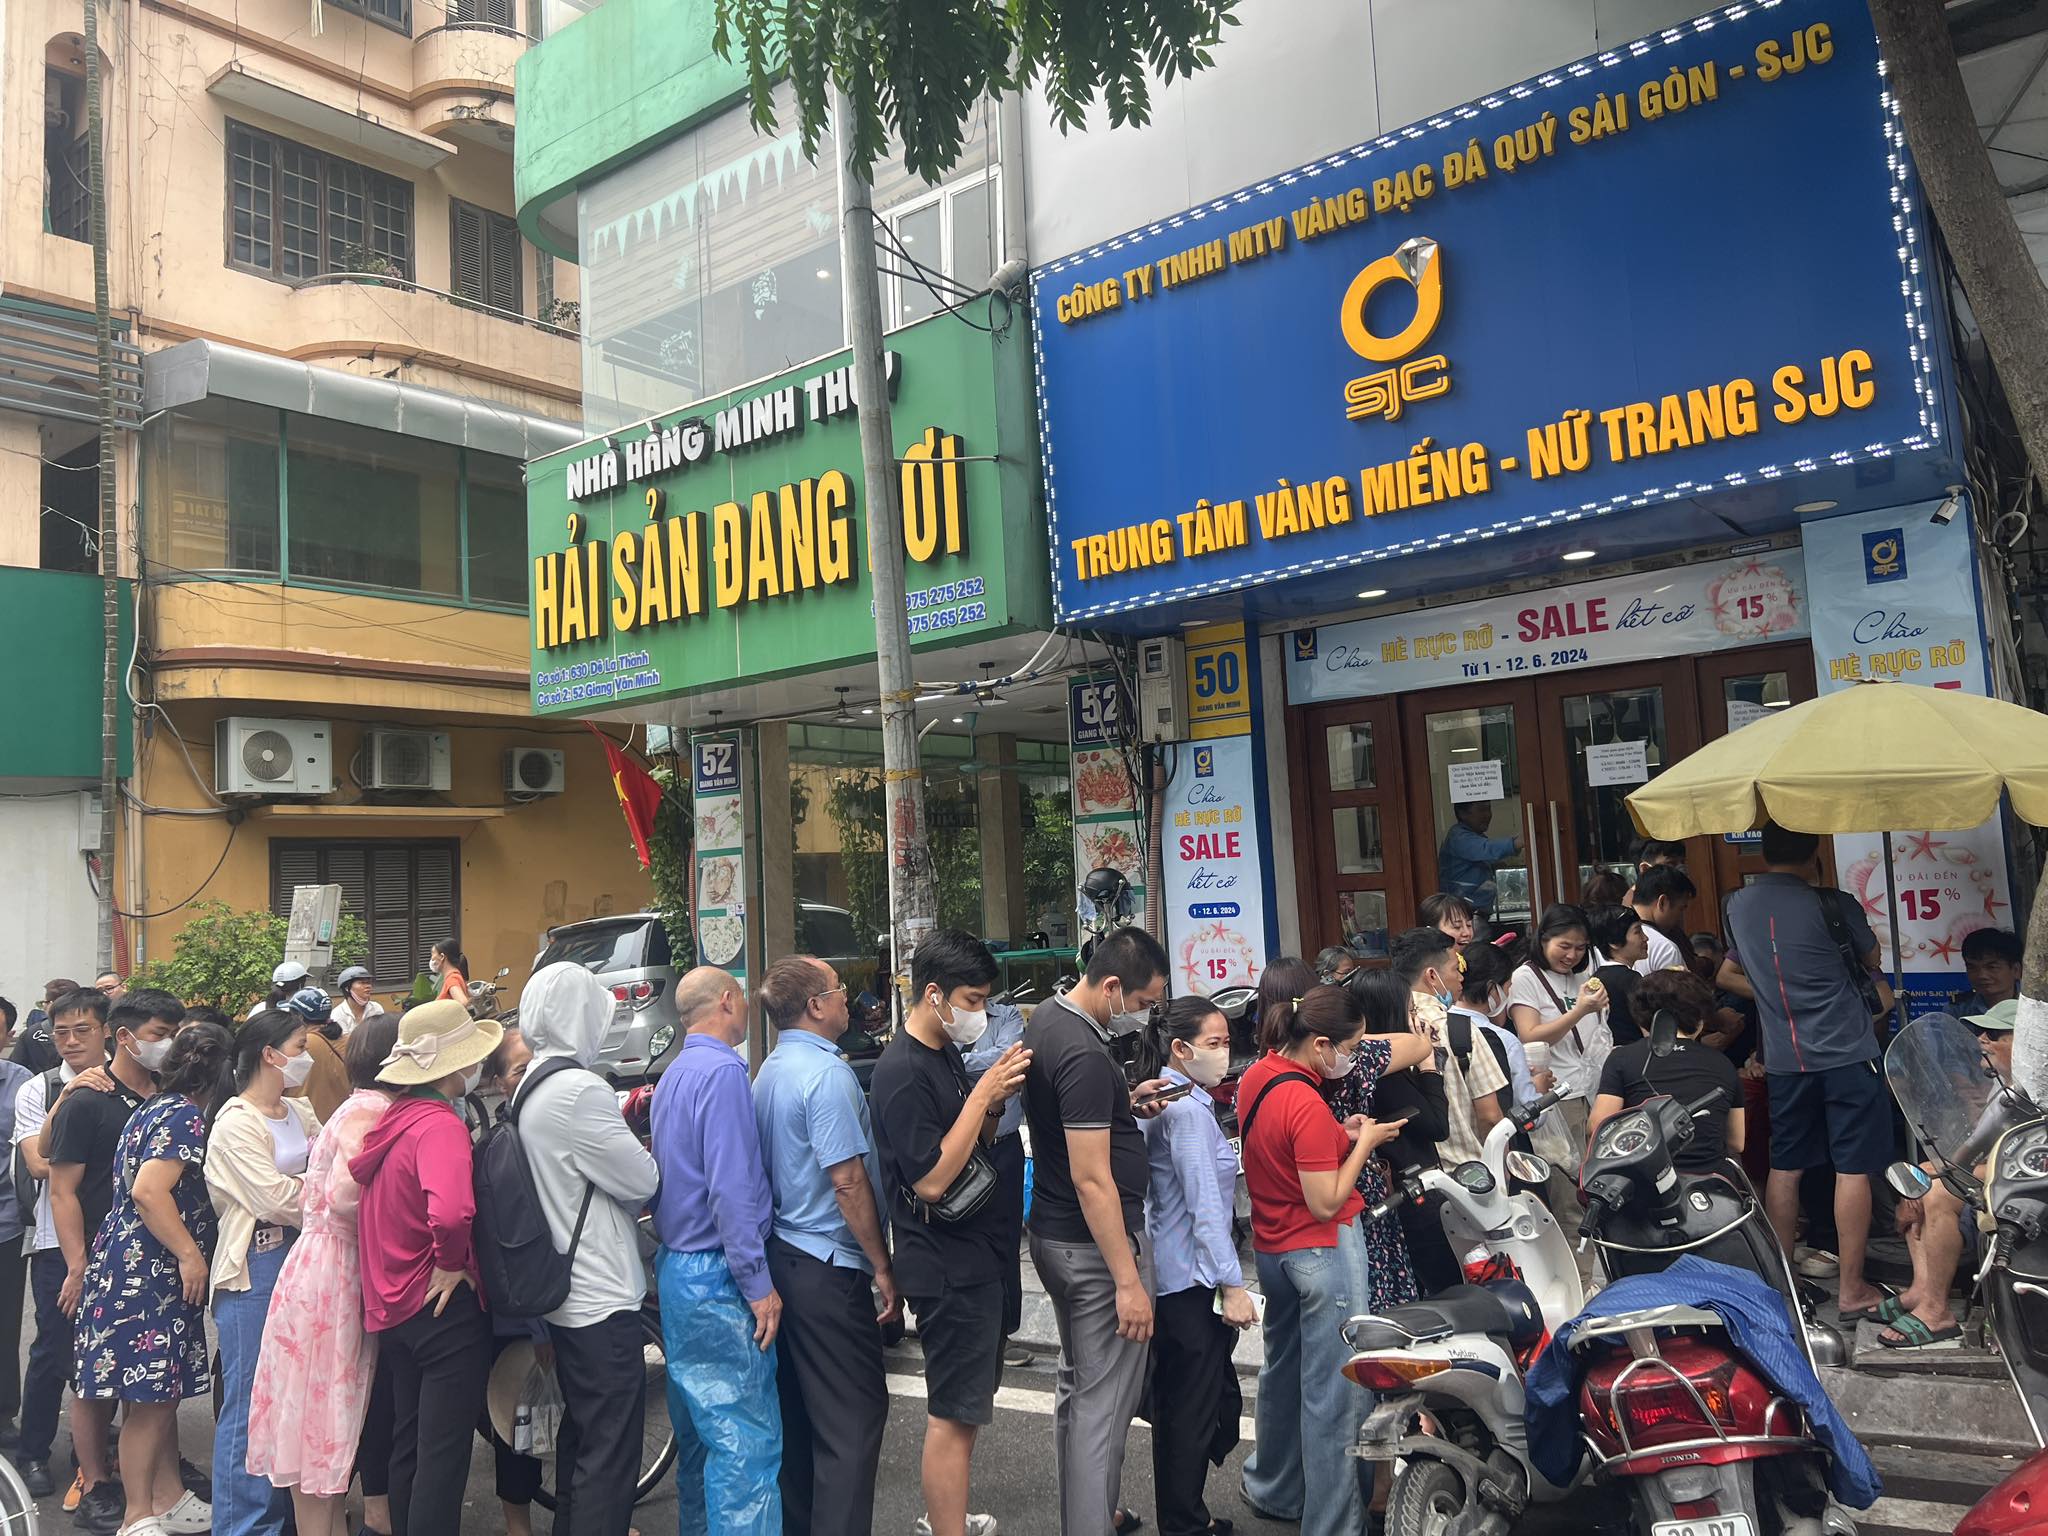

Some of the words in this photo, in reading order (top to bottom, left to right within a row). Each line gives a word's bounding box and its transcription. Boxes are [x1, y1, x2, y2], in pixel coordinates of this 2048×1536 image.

[1056, 277, 1121, 324] CÔNG
[1123, 263, 1155, 301] TY
[1157, 239, 1225, 289] TNHH
[1228, 215, 1286, 264] MTV
[1291, 187, 1368, 241] VÀNG
[1372, 163, 1435, 214] BẠC
[1442, 136, 1488, 189] ĐÁ
[1492, 111, 1559, 174] QUÝ
[1567, 92, 1630, 144] SÀI
[1638, 60, 1719, 121] GÒN
[1754, 22, 1835, 81] SJC
[1343, 353, 1452, 423] SJC
[566, 437, 622, 501] NHÀ
[625, 420, 708, 482] HÀNG
[714, 385, 799, 453] MINH
[804, 350, 893, 421] TH
[1071, 519, 1175, 581] TRUNG
[1176, 498, 1249, 558] TÂM
[1254, 477, 1353, 540] VÀNG
[1360, 436, 1491, 518] MIẾNG
[1500, 456, 1519, 471] -
[1526, 408, 1593, 481] NỮ
[1599, 378, 1760, 464] TRANG
[1771, 349, 1876, 425] SJC
[534, 513, 603, 651] HẢI
[611, 487, 704, 633] SẢN
[712, 469, 853, 609] ĐANG
[929, 583, 955, 606] 275
[956, 575, 985, 599] 252
[930, 607, 957, 630] 265
[959, 601, 987, 624] 252
[1852, 610, 1929, 644] Chào
[1326, 645, 1374, 671] Chào
[1381, 633, 1409, 663] HÈ
[1414, 631, 1457, 661] RỰC
[1463, 622, 1494, 651] RỠ
[1517, 597, 1609, 643] SALE
[1615, 597, 1665, 631] hết
[1662, 603, 1695, 625] cỡ
[537, 671, 550, 687] Cơ
[550, 667, 561, 684] sở
[570, 663, 588, 680] 630
[605, 657, 617, 672] La
[618, 649, 650, 670] Thành
[1194, 652, 1240, 698] 50
[1461, 661, 1479, 678] Từ
[1483, 661, 1490, 674] 1
[1551, 647, 1589, 666] 2024
[1828, 652, 1863, 681] HÈ
[1868, 648, 1921, 677] RỰC
[1928, 638, 1966, 669] RỠ
[537, 692, 550, 707] Cơ
[550, 687, 561, 703] sở
[572, 685, 585, 701] 52
[585, 682, 613, 697] Giang
[613, 676, 634, 691] Văn
[635, 668, 660, 689] Minh
[1081, 684, 1119, 725] 52
[1078, 728, 1098, 740] GIANG
[702, 746, 733, 777] 52
[1187, 783, 1226, 806] Chào
[1175, 809, 1191, 828] HÈ
[1194, 808, 1220, 828] RỰC
[1223, 804, 1243, 824] RỠ
[1179, 831, 1242, 862] SALE
[1187, 866, 1218, 890] hết
[1216, 874, 1238, 890] cỡ
[1220, 905, 1236, 915] 2024
[1899, 887, 1961, 922] 15%
[1660, 1452, 1703, 1465] HONDA
